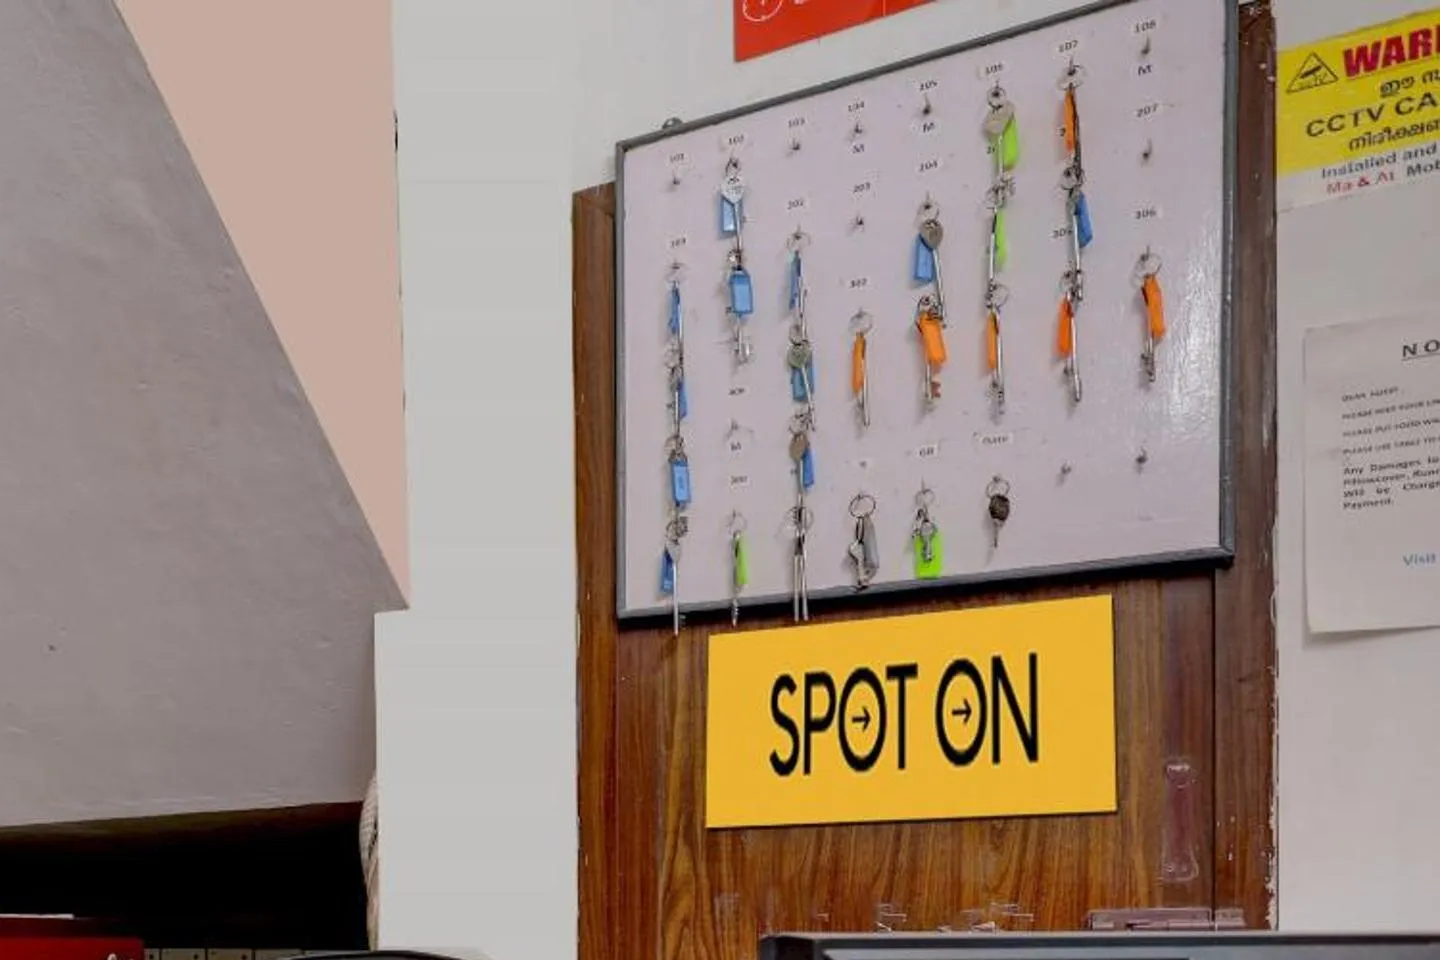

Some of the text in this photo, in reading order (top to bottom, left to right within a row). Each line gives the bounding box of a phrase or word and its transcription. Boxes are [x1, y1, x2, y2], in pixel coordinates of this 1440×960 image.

[1306, 103, 1385, 138] CCTV
[1321, 141, 1437, 179] Installed and
[769, 652, 1039, 777] SPOT ON
